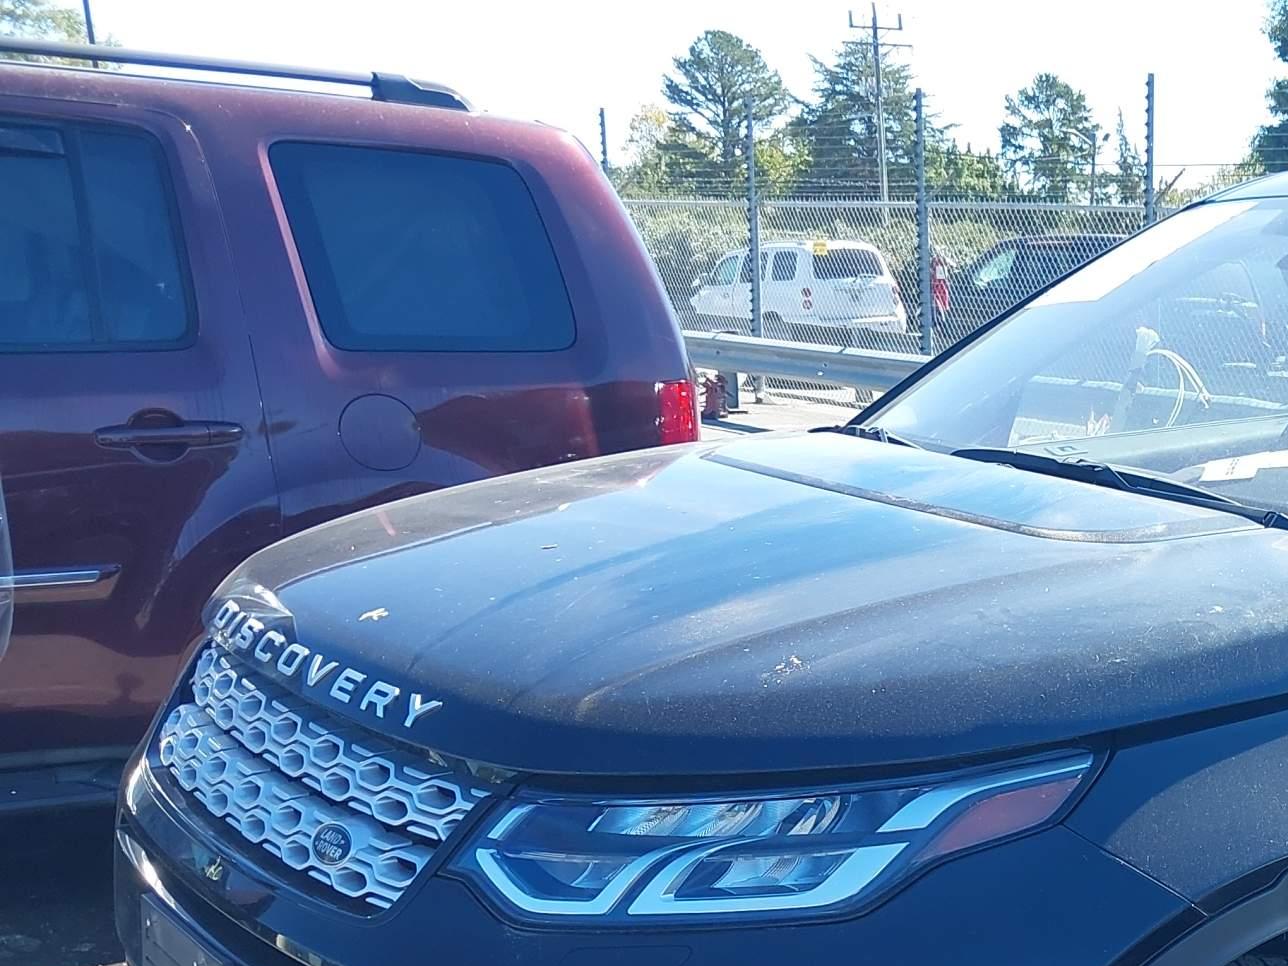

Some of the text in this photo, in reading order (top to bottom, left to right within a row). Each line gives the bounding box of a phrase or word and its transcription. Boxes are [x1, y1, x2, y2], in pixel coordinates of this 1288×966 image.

[214, 600, 442, 727] DISCOVERY
[320, 828, 342, 845] LAND
[317, 840, 342, 860] ROVER
